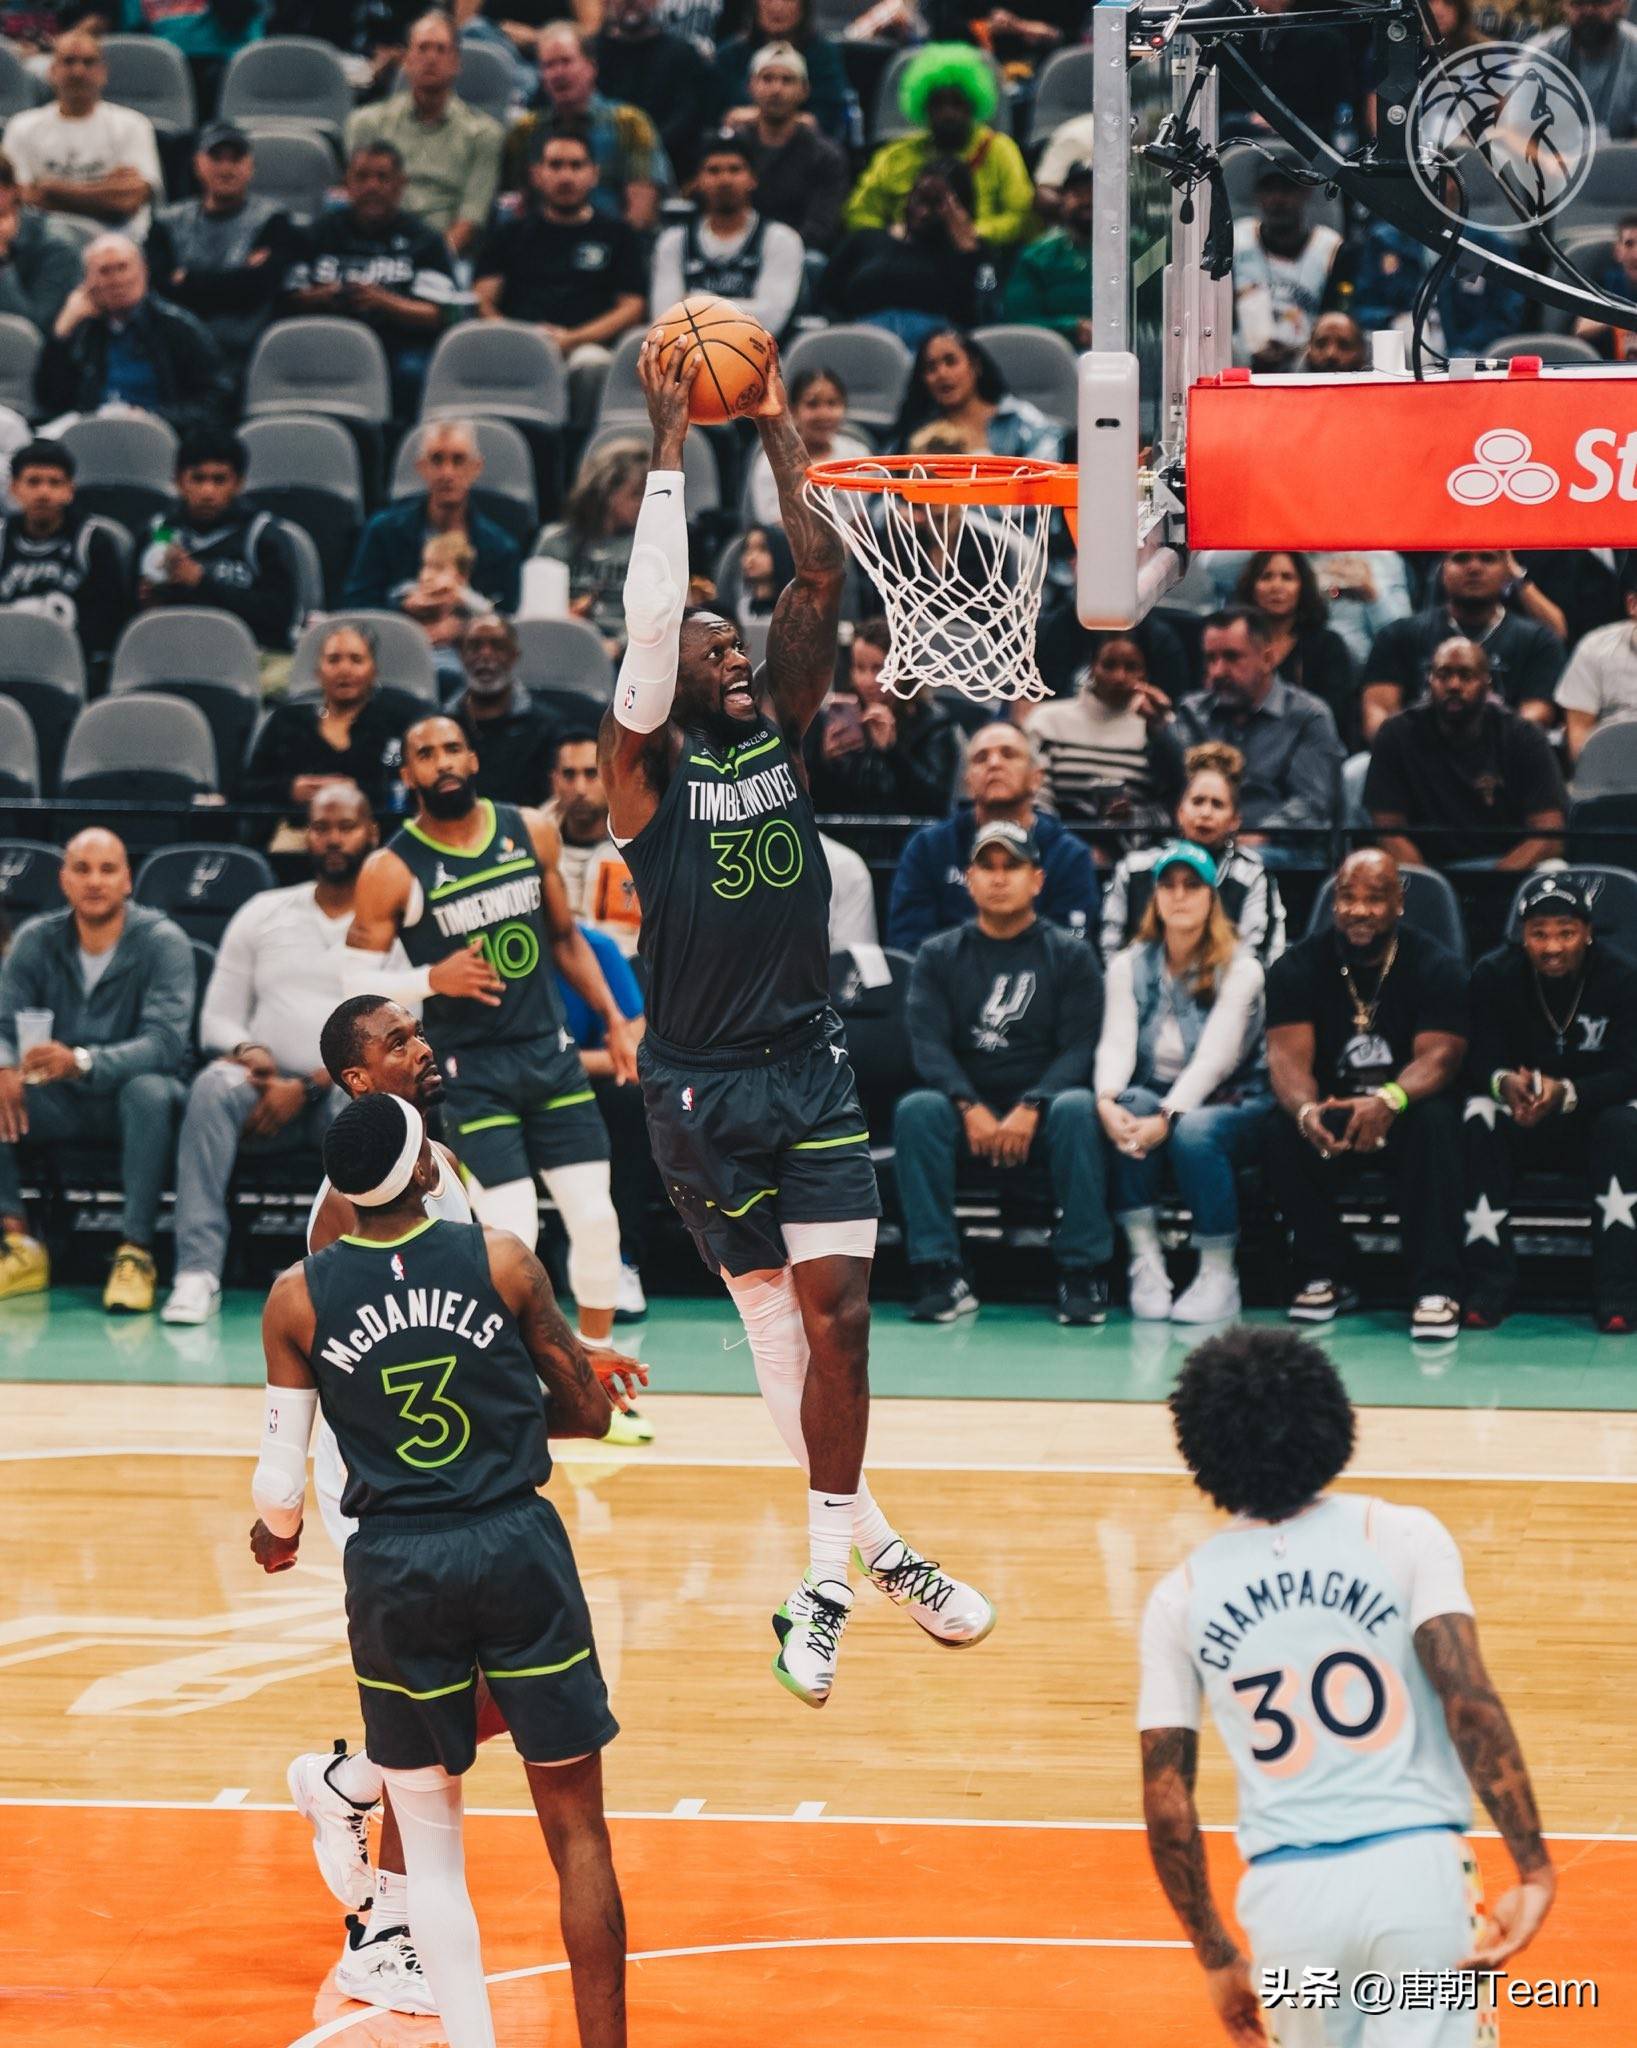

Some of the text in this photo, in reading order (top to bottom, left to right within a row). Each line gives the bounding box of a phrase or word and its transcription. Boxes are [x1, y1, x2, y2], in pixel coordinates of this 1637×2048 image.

[710, 819, 803, 900] 30
[320, 1287, 504, 1375] McDANIELS
[380, 1355, 471, 1469] 3
[1199, 1569, 1400, 1671] CHAMPAGNIE
[1231, 1650, 1388, 1765] 30
